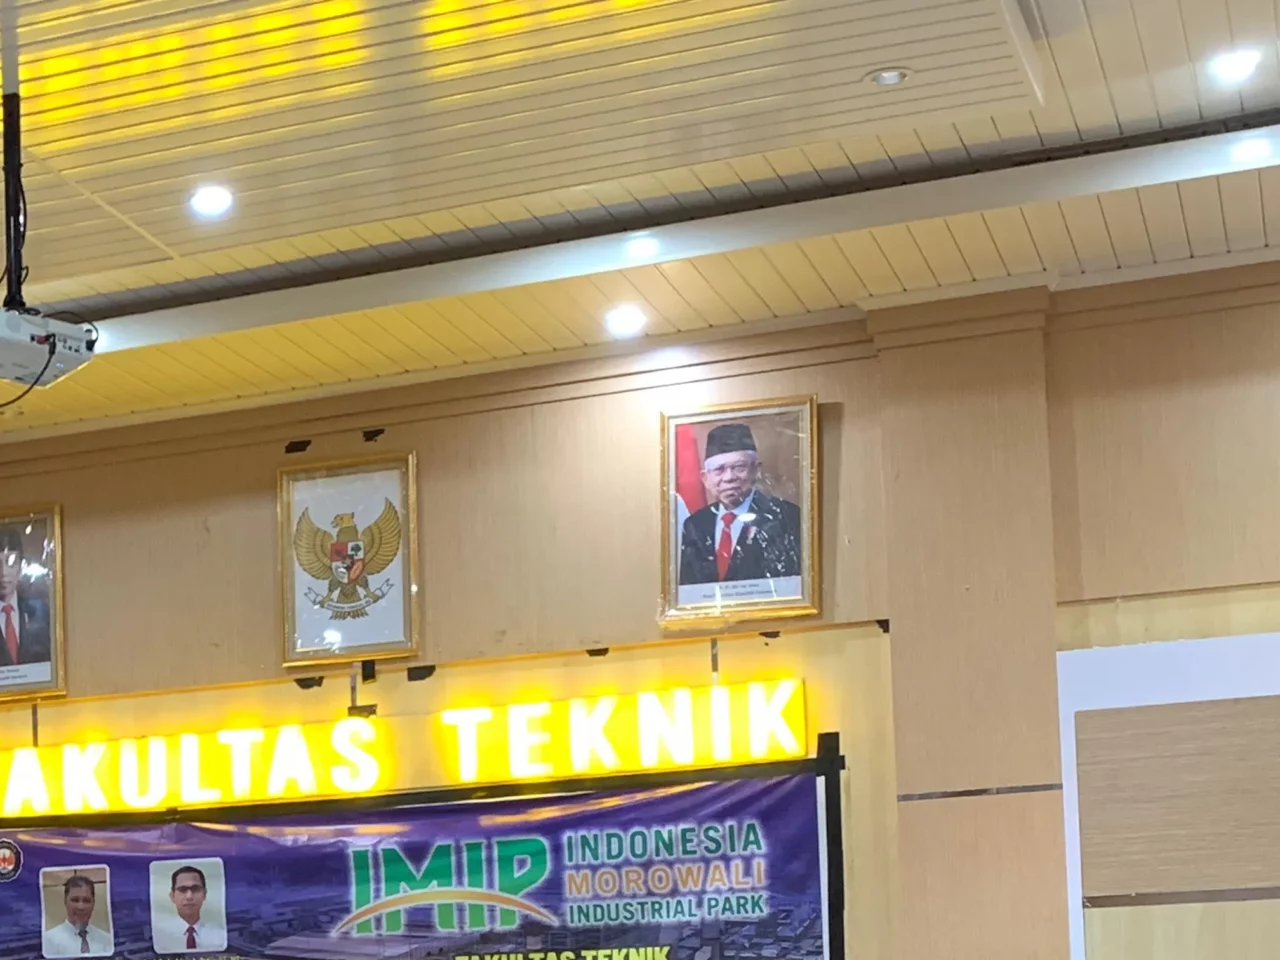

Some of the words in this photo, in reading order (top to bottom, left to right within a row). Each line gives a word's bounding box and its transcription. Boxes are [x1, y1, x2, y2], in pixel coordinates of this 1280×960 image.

[441, 678, 803, 783] TEKNIK
[567, 822, 763, 863] INDONESIA
[350, 838, 548, 934] IMIP
[568, 861, 764, 896] MOROWALI
[569, 899, 698, 925] INDUSTRIAL
[707, 894, 765, 917] PARK
